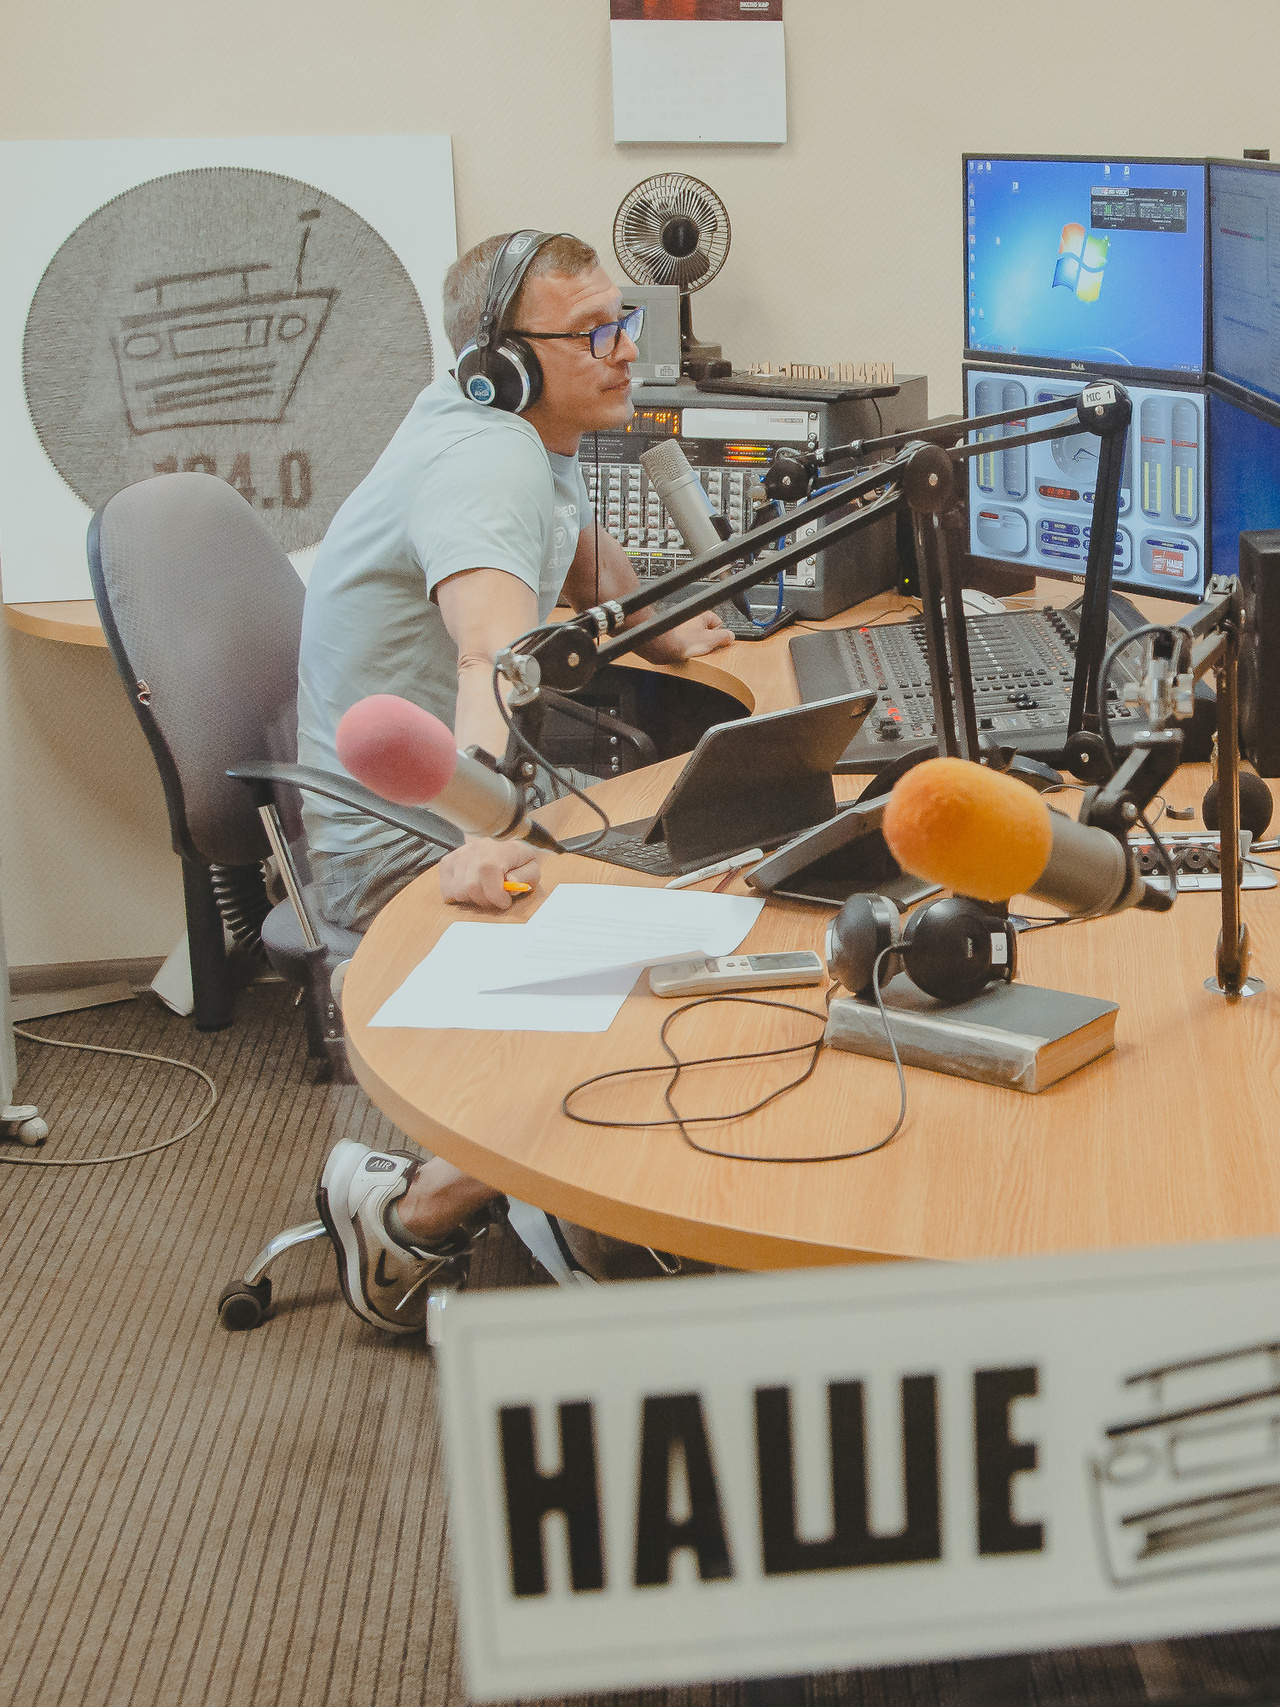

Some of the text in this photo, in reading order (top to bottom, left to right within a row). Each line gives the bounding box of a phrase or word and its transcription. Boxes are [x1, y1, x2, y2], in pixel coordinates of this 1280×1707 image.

[1086, 391, 1111, 402] MIC 1
[153, 451, 312, 508] 4.0
[370, 1159, 392, 1170] AIR
[498, 1364, 1046, 1598] НАШЕ
